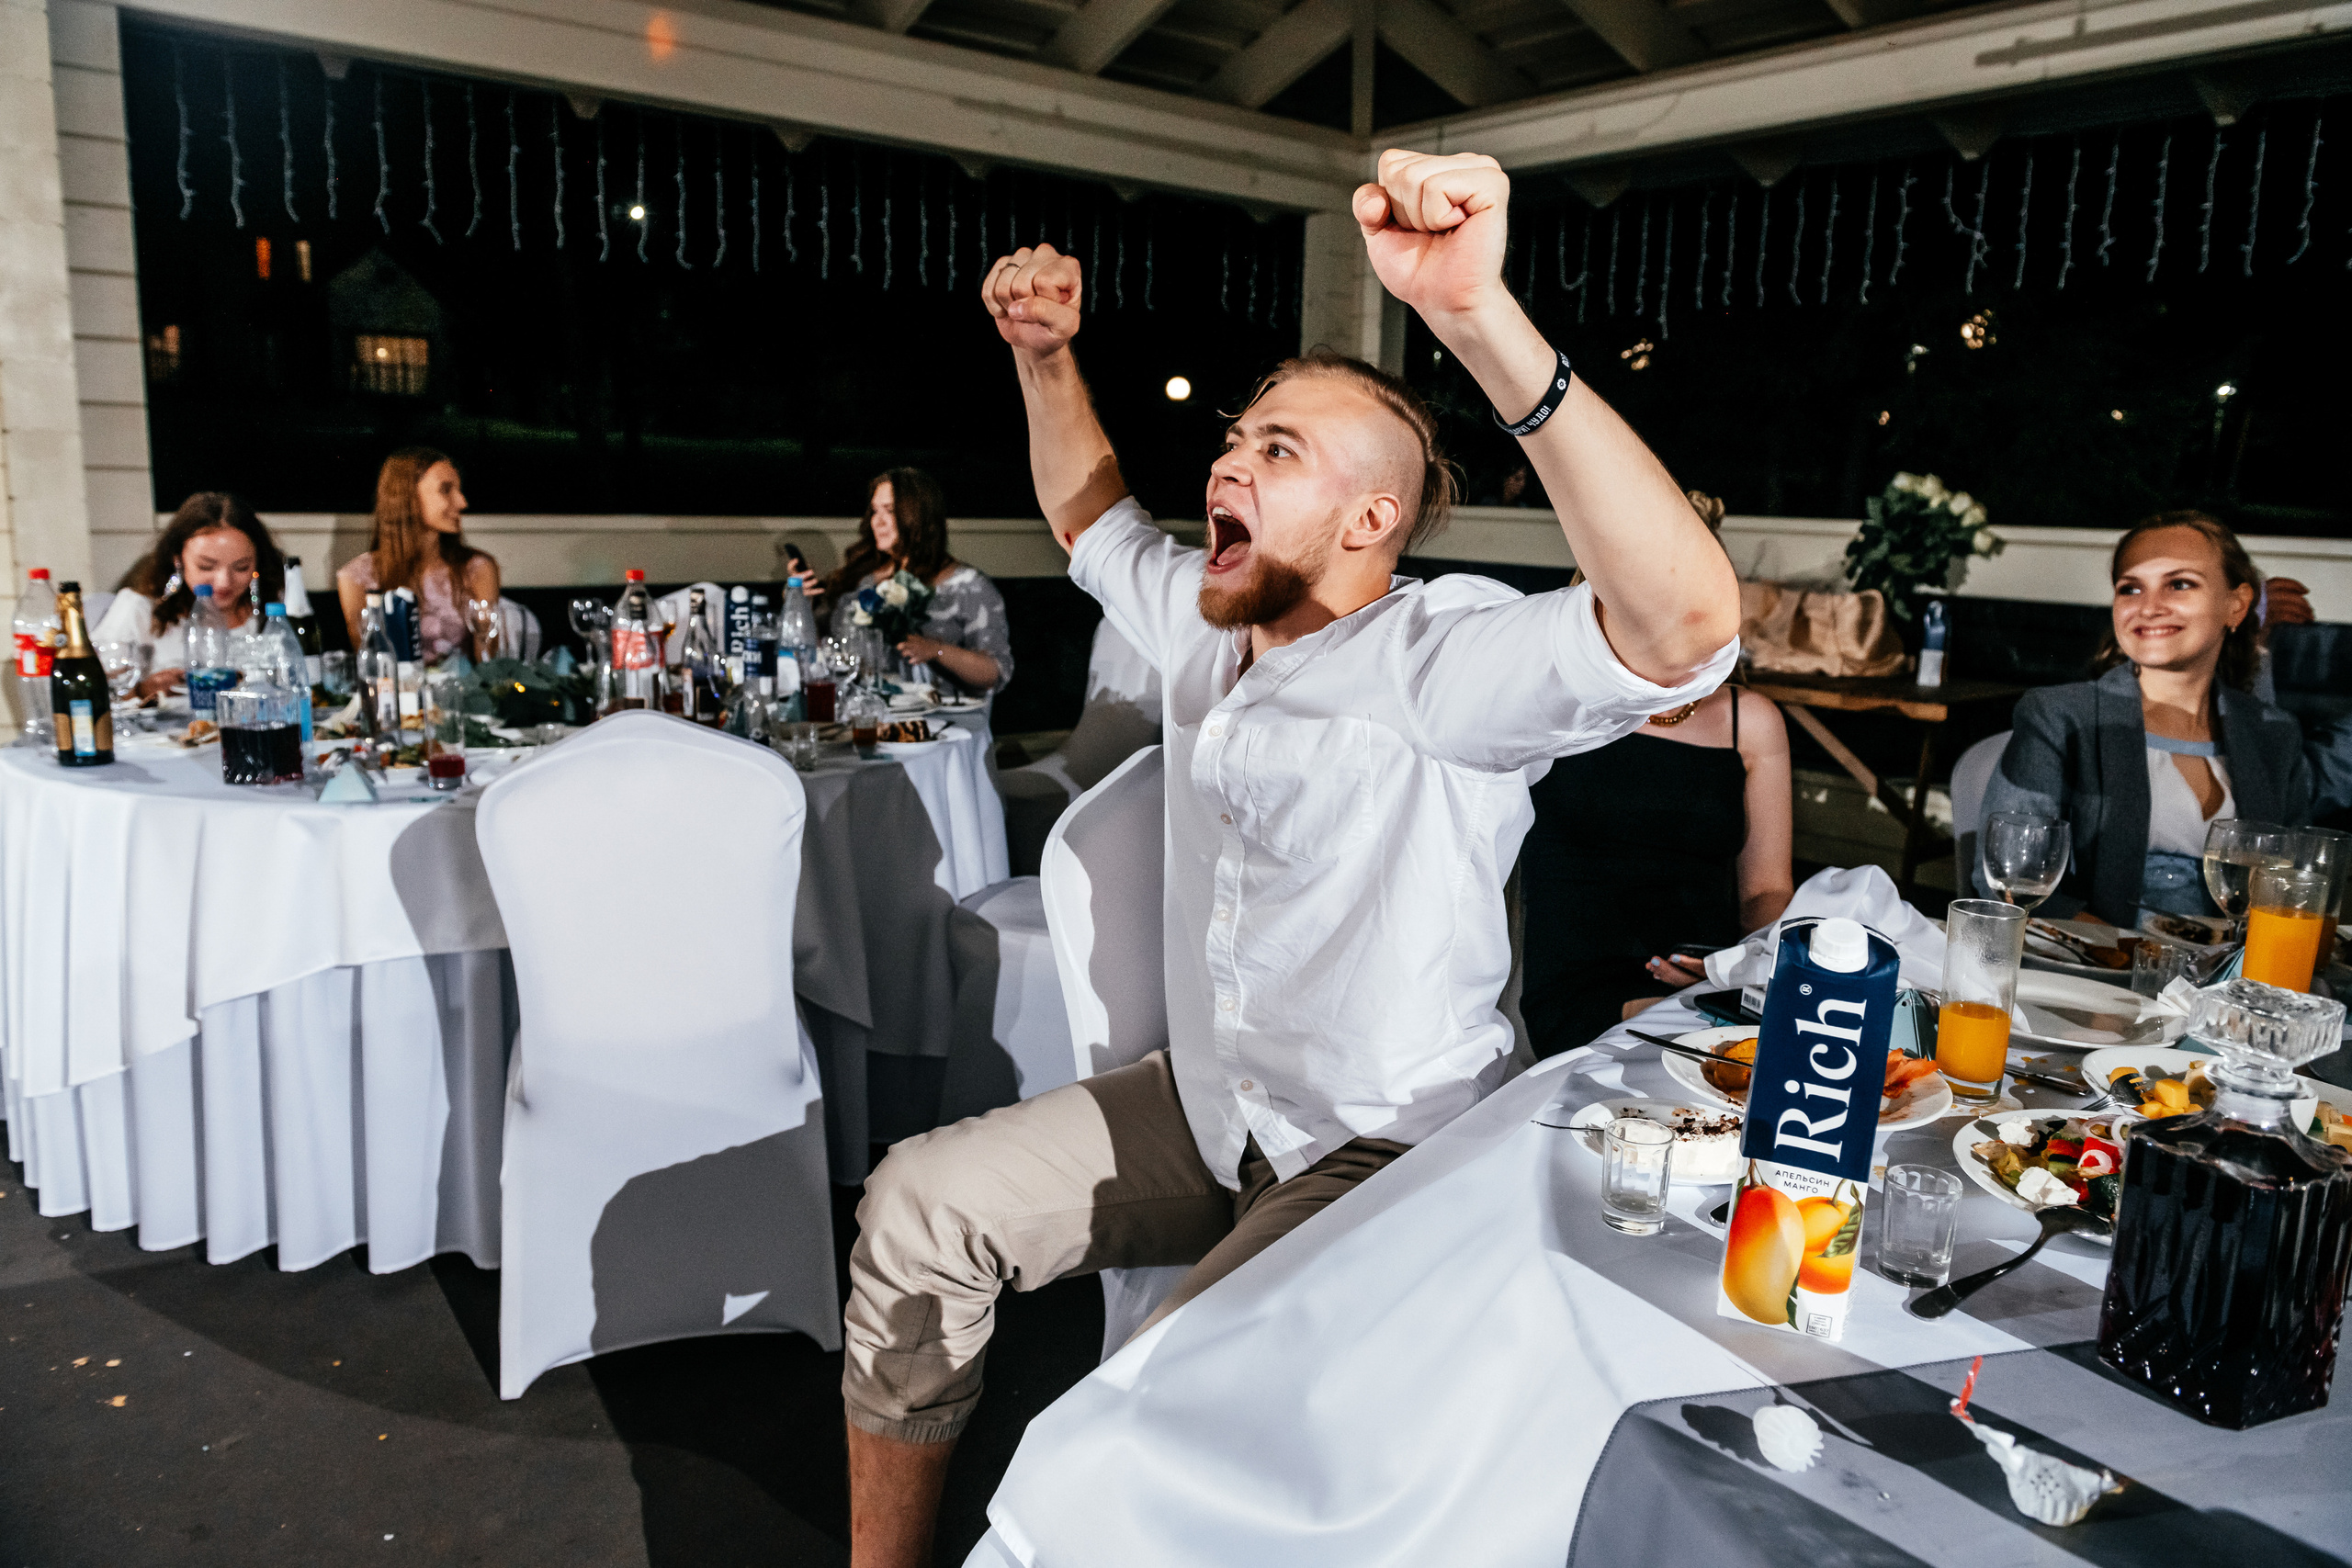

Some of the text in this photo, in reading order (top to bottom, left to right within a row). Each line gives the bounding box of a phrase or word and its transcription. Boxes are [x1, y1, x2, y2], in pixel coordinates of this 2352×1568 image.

[1526, 405, 1552, 426] ЧУДО!
[1775, 1169, 1830, 1188] АПЕЛЬСИН
[1783, 1180, 1819, 1194] МАНГО
